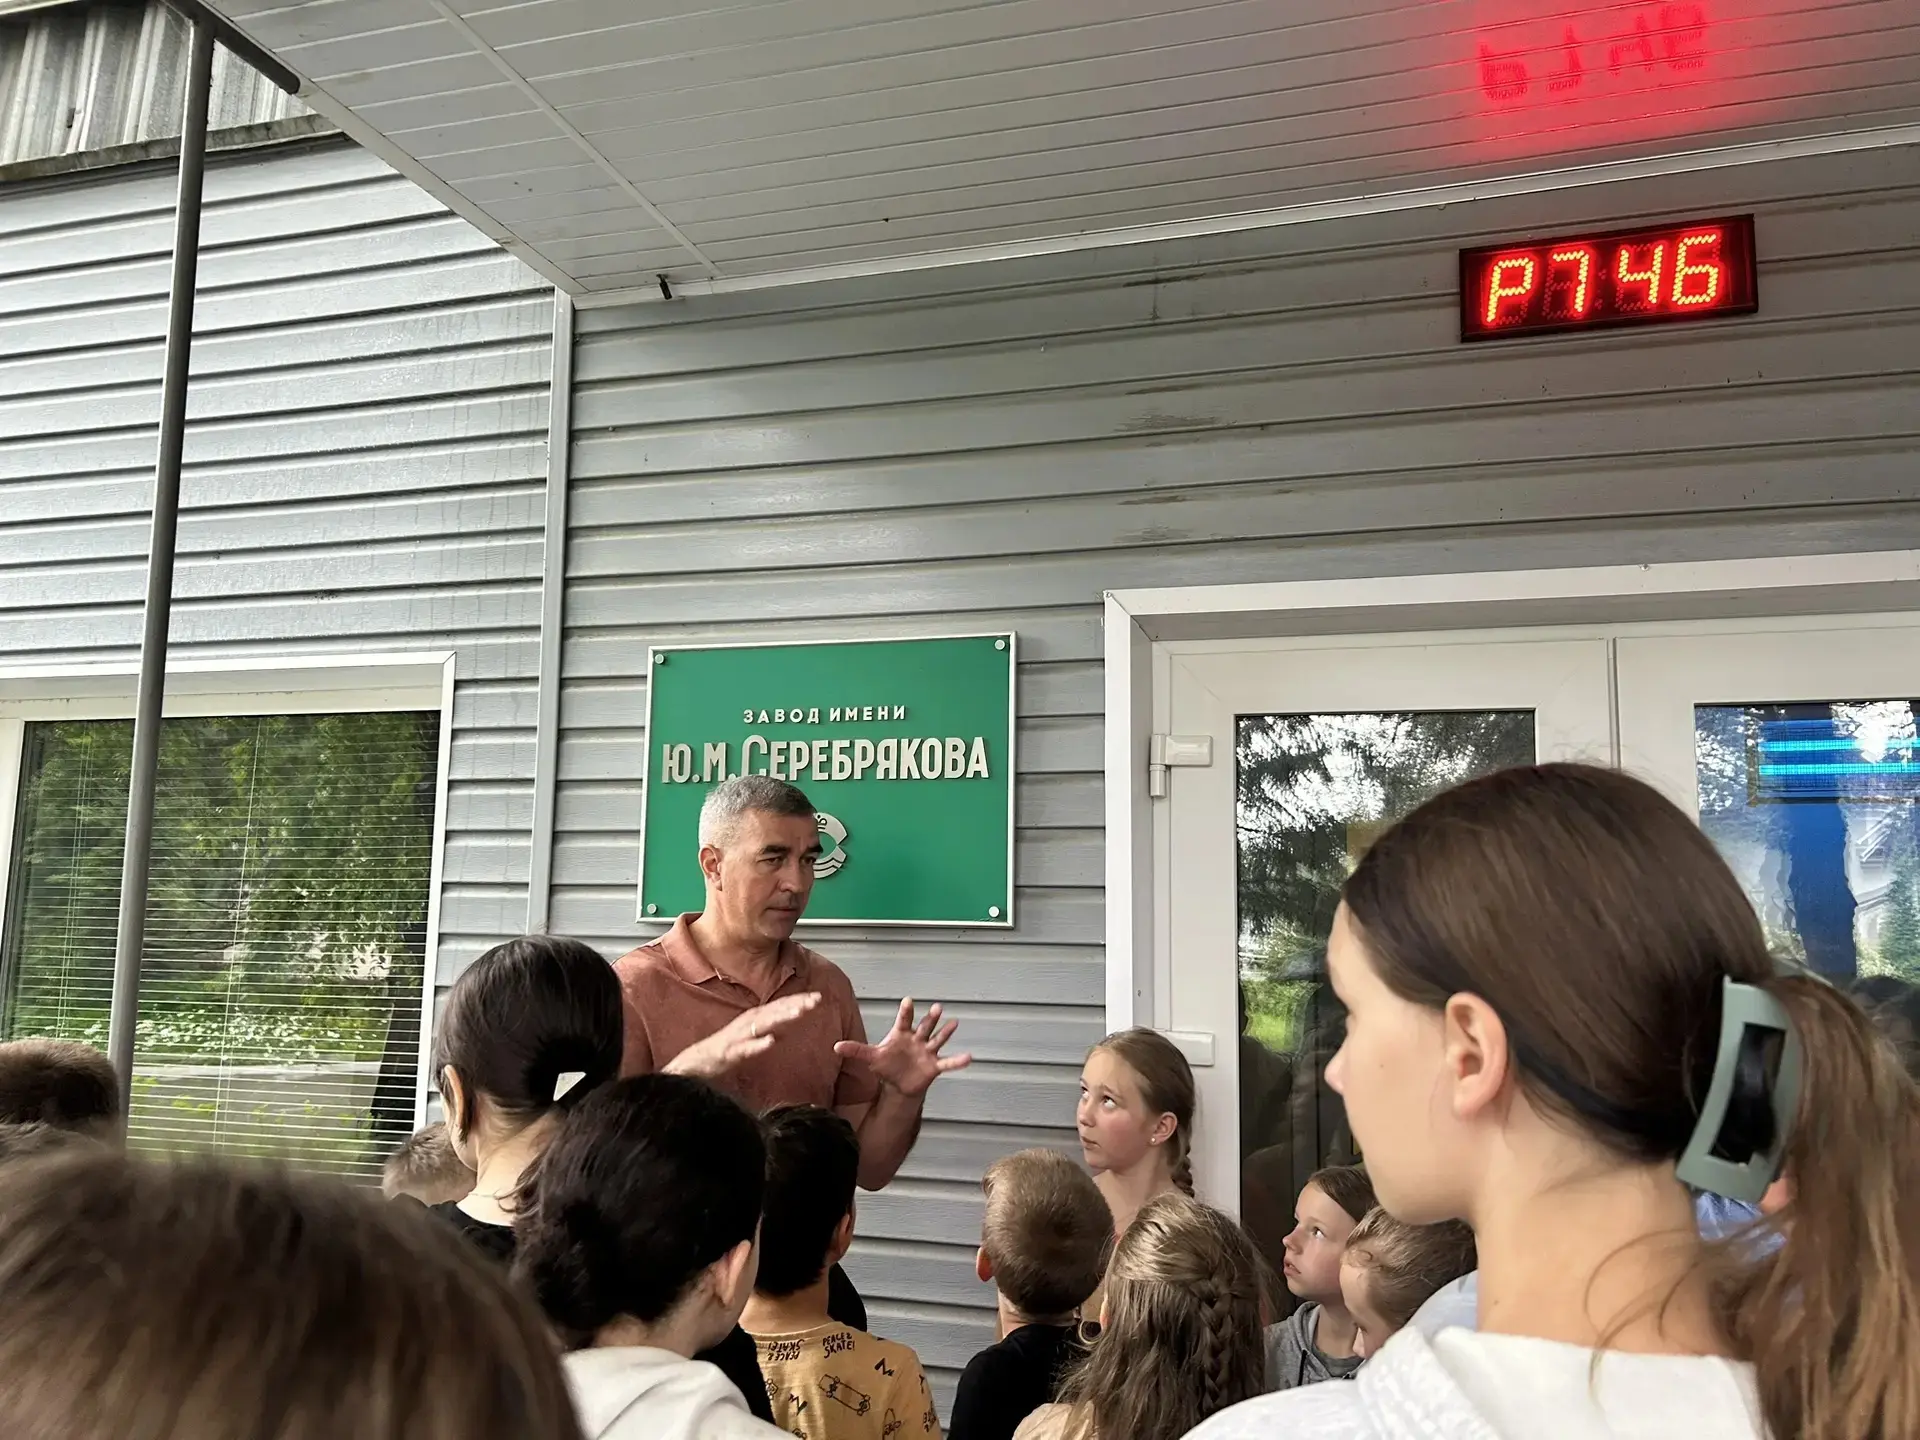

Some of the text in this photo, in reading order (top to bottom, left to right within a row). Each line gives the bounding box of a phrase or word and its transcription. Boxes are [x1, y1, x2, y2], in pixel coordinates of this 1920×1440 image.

[743, 705, 906, 724] ЗАВОД ИМЕНИ
[823, 1332, 845, 1346] PEACE
[823, 1340, 856, 1359] SKATE!
